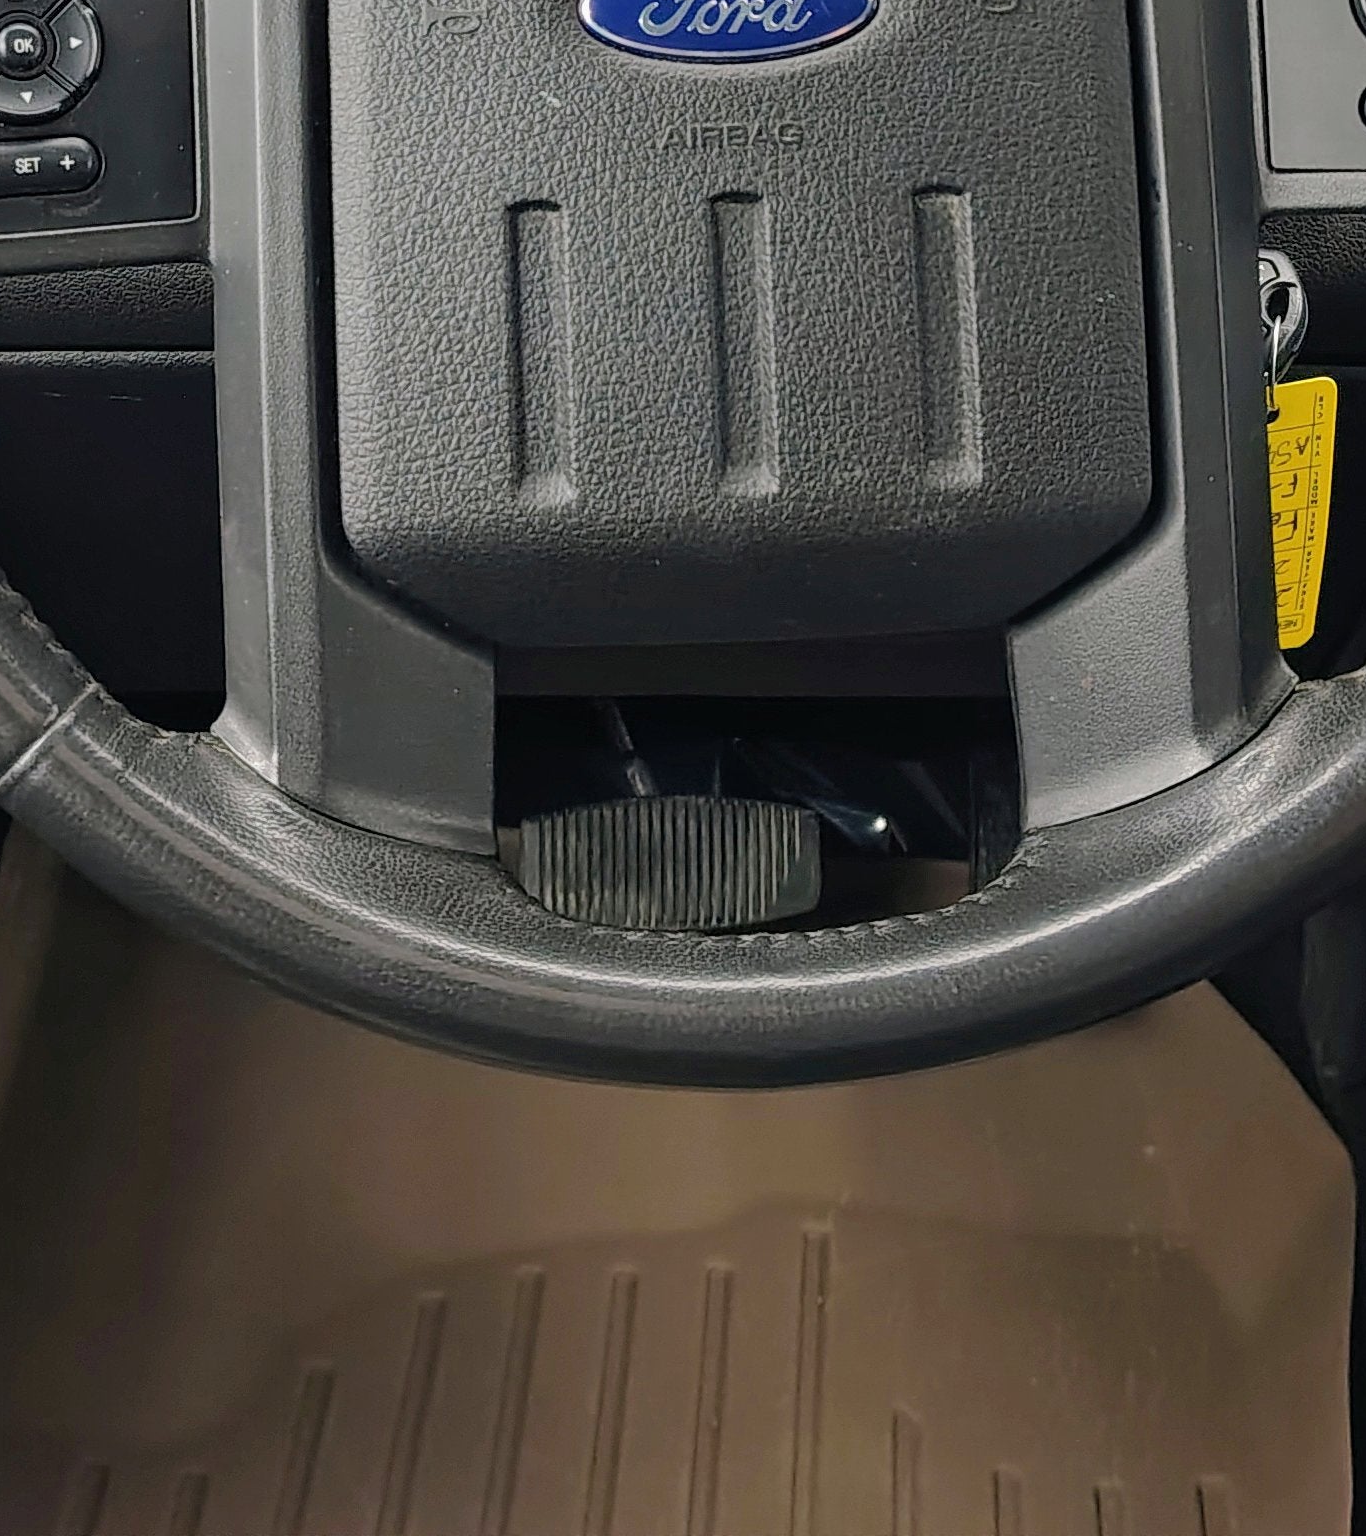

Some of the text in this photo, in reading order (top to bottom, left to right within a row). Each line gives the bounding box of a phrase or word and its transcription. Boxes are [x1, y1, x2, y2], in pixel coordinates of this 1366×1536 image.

[12, 37, 35, 54] OK
[661, 121, 806, 152] AIRBAG
[13, 156, 42, 175] SET
